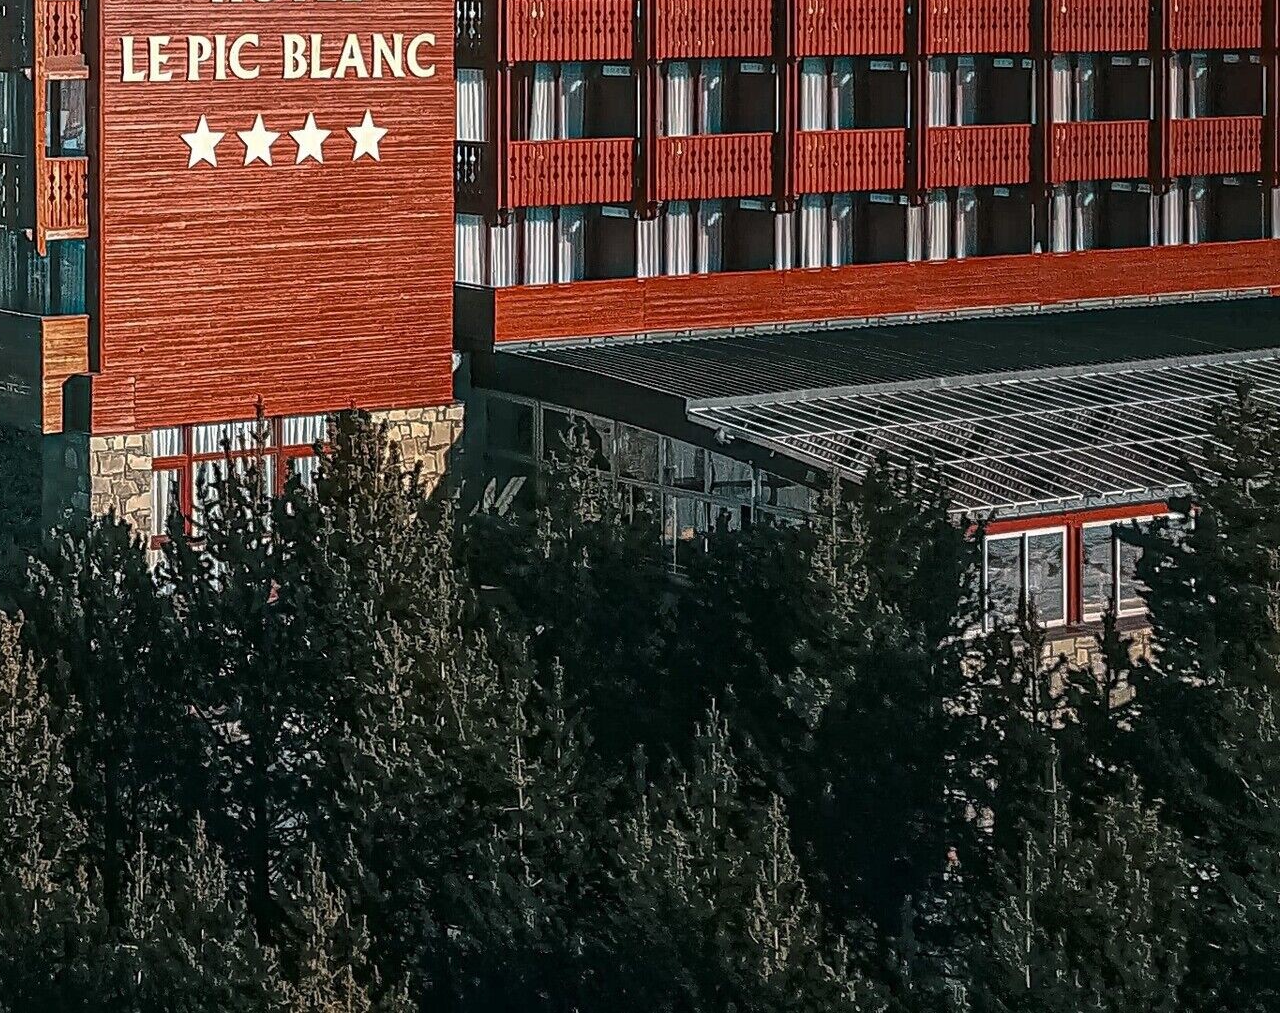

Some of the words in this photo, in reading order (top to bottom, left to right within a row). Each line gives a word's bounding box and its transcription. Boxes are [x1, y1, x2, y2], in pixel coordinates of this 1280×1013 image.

[120, 35, 173, 83] LE
[185, 33, 261, 82] PIC
[281, 31, 437, 80] BLANC
